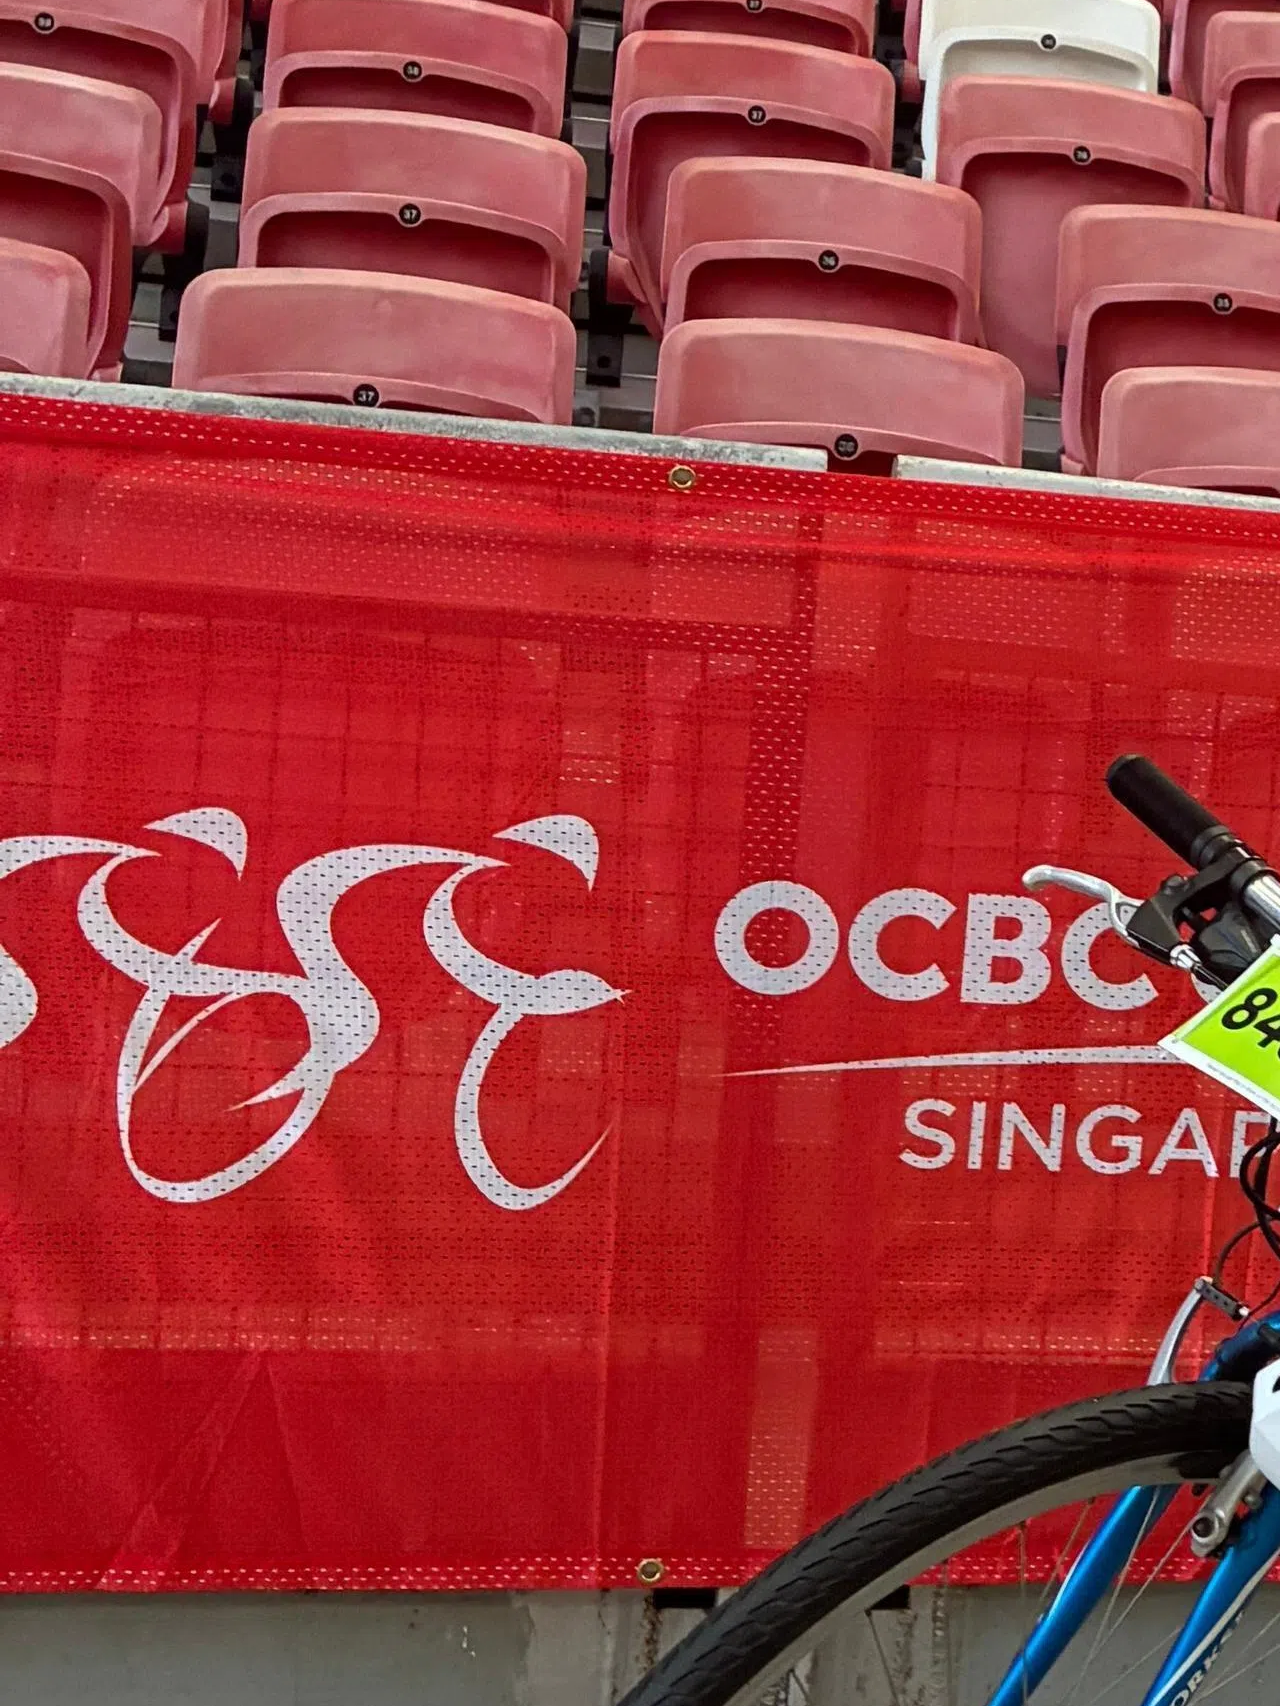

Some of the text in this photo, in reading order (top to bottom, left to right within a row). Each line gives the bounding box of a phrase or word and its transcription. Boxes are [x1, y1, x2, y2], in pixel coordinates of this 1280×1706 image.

[751, 110, 763, 120] 37
[403, 208, 417, 220] 37
[358, 390, 374, 402] 37
[715, 880, 1159, 1011] OCBC
